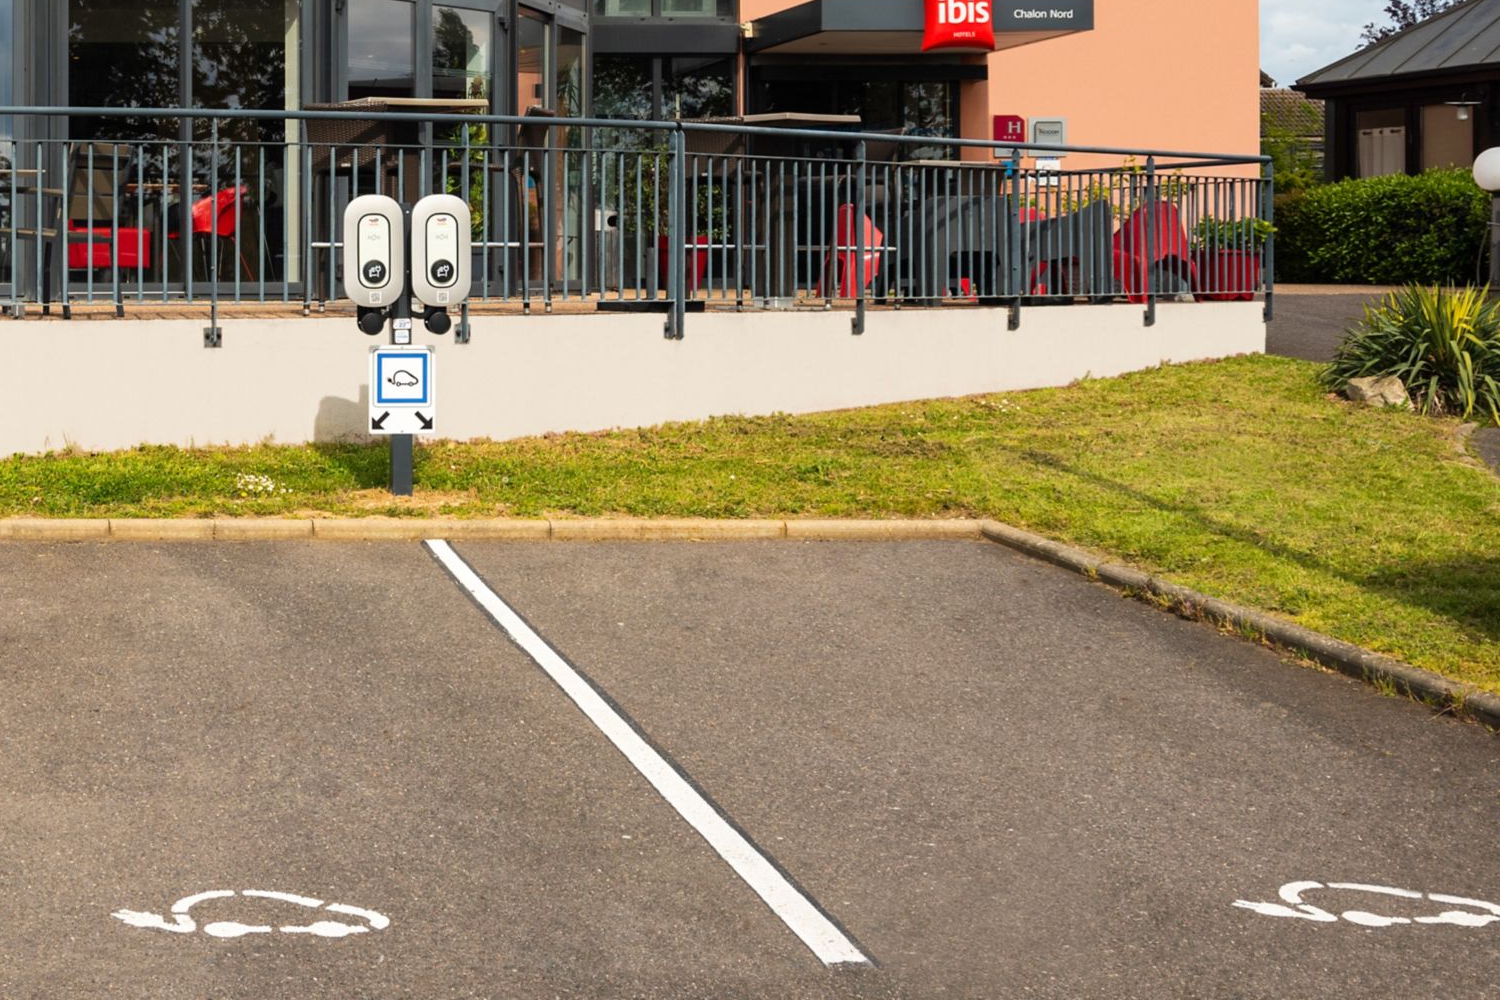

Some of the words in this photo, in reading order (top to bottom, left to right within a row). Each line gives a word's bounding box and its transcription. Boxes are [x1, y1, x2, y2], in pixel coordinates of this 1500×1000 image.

[1013, 9, 1047, 19] Chalon
[1049, 9, 1074, 19] Nord
[1007, 121, 1021, 134] H
